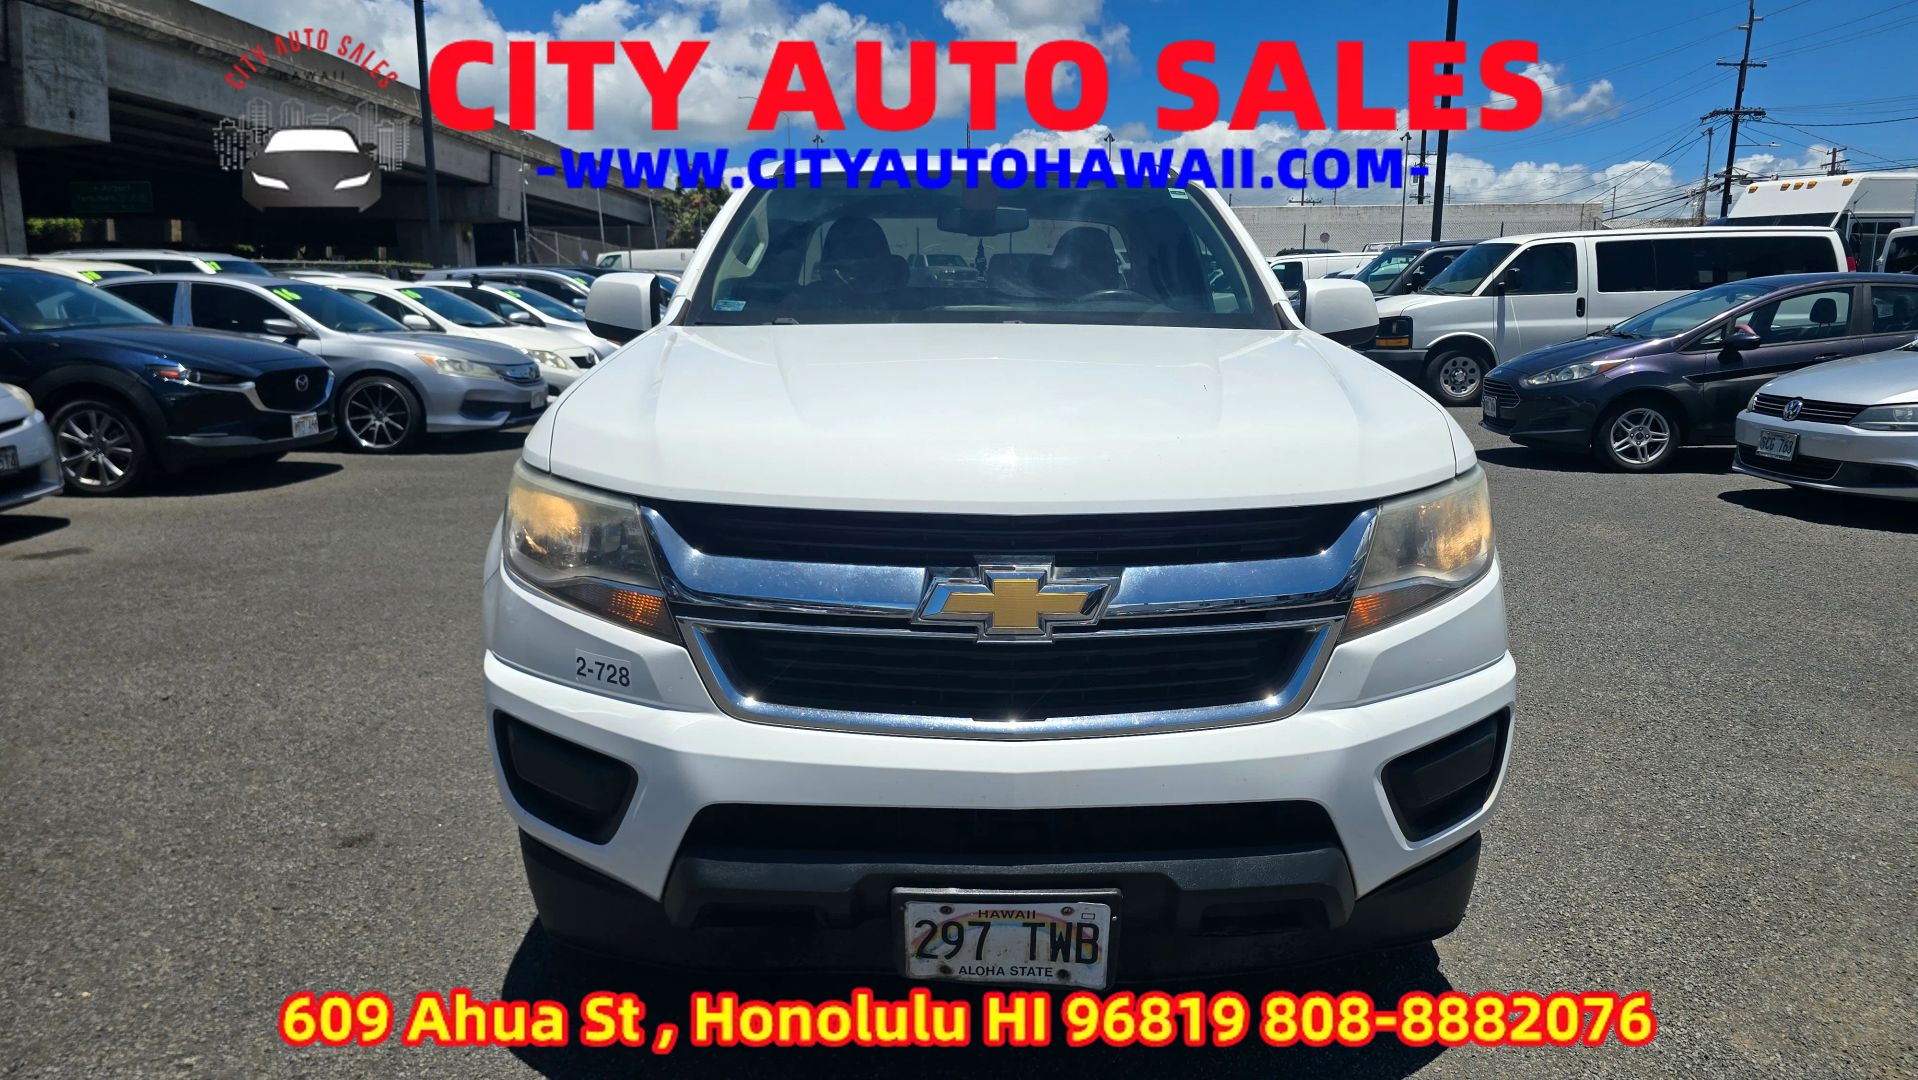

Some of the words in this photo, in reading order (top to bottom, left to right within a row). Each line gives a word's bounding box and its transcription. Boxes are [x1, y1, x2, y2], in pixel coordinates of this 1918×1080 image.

[576, 656, 631, 687] 2-728
[978, 909, 1036, 920] HAWAII
[914, 919, 991, 961] 297
[1022, 922, 1100, 965] TWB
[958, 966, 1006, 976] ALOHA
[1009, 966, 1053, 977] STATE
